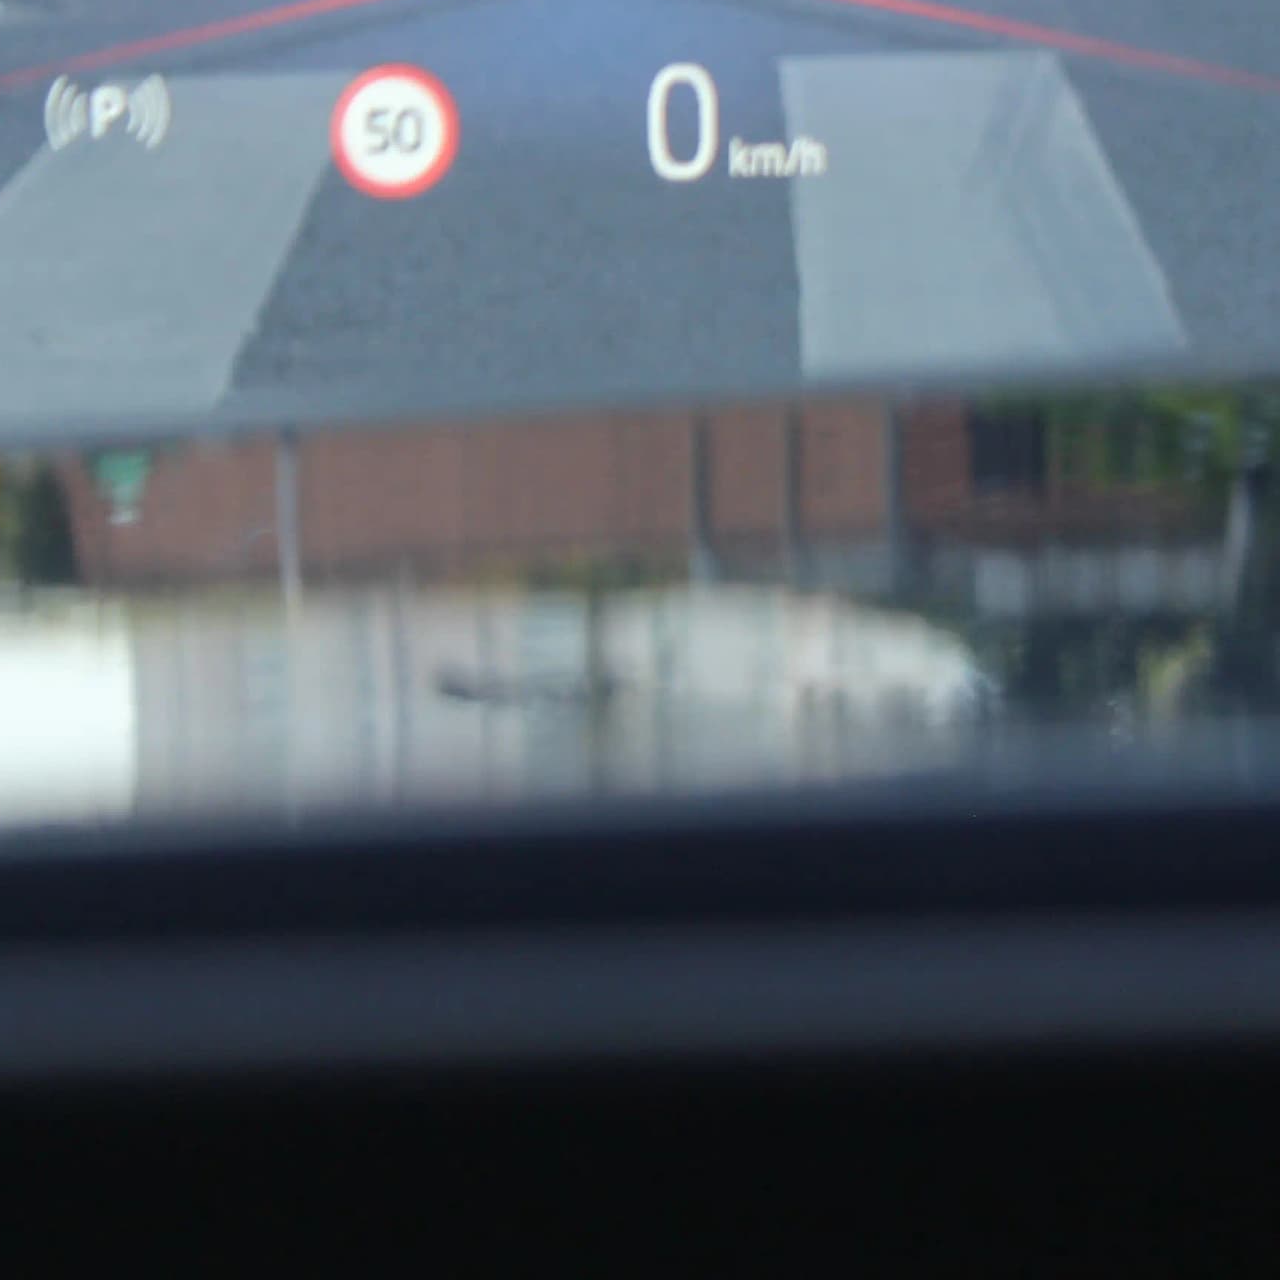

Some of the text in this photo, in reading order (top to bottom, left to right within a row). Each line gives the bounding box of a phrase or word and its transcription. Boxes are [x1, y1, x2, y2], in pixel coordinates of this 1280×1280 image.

[89, 85, 127, 139] P
[366, 107, 424, 155] 50
[647, 61, 827, 182] 0 km/h
